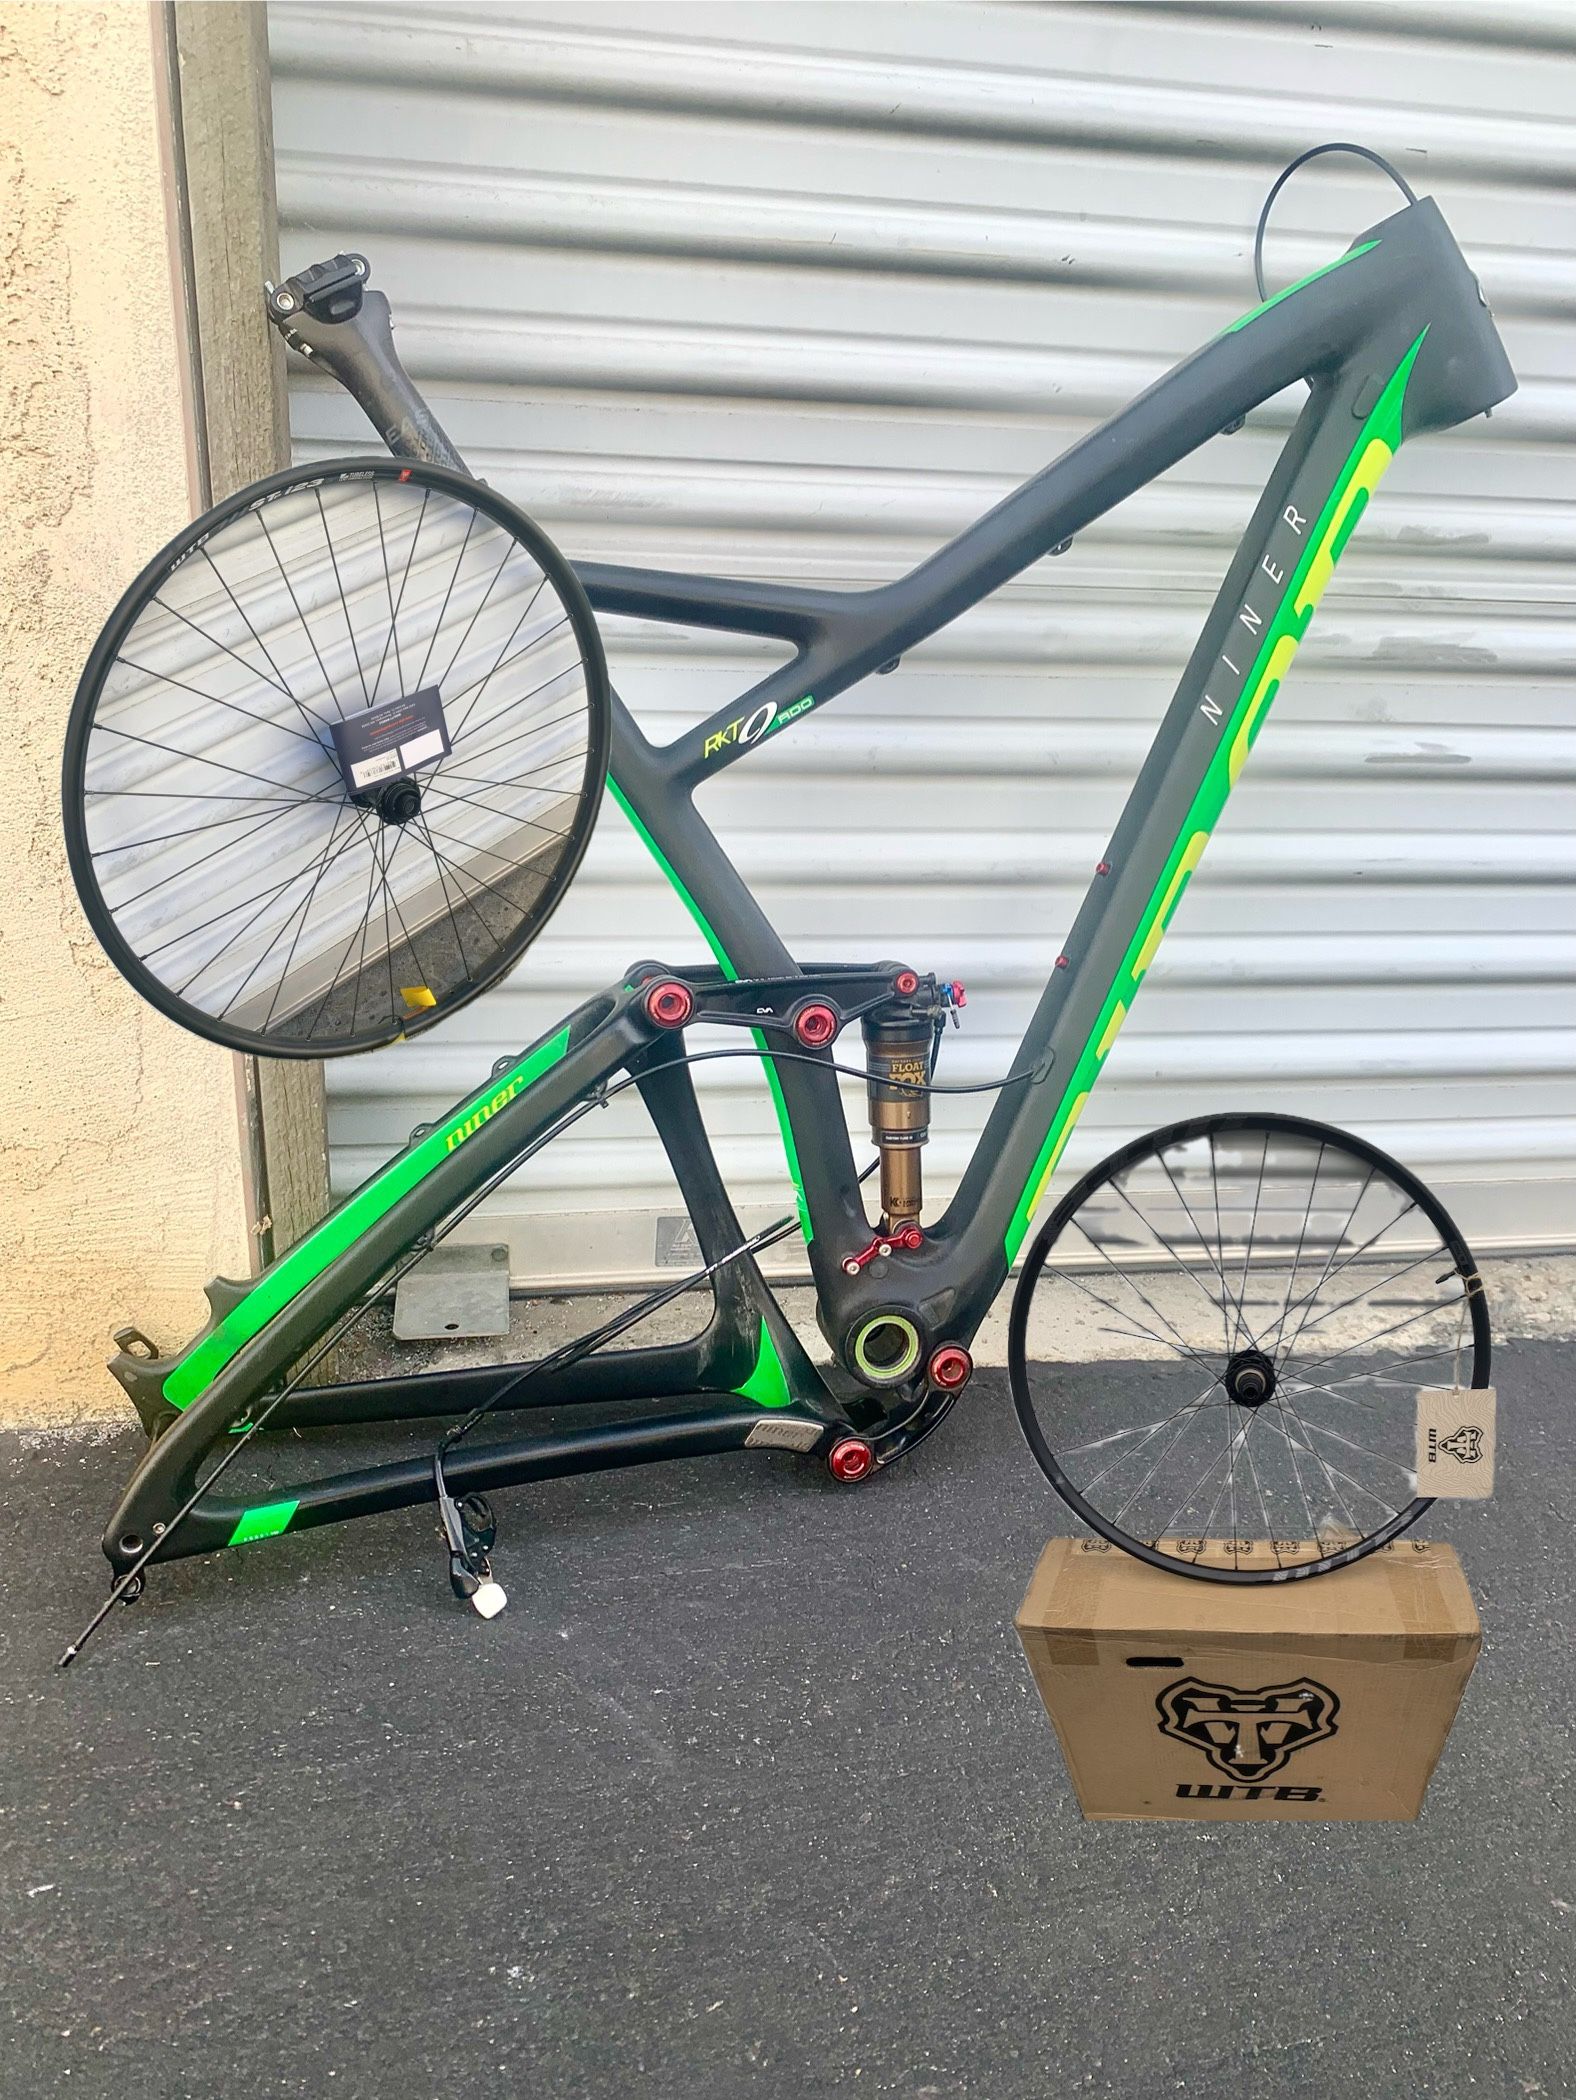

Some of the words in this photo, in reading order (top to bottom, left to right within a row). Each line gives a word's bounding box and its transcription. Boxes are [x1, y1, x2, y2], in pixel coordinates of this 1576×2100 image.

[170, 532, 210, 572] WTB
[1200, 504, 1307, 726] NINER
[891, 1060, 924, 1073] FLOAT
[445, 1075, 524, 1153] niner
[1428, 1428, 1437, 1463] WTB
[1175, 1783, 1323, 1801] WTB
